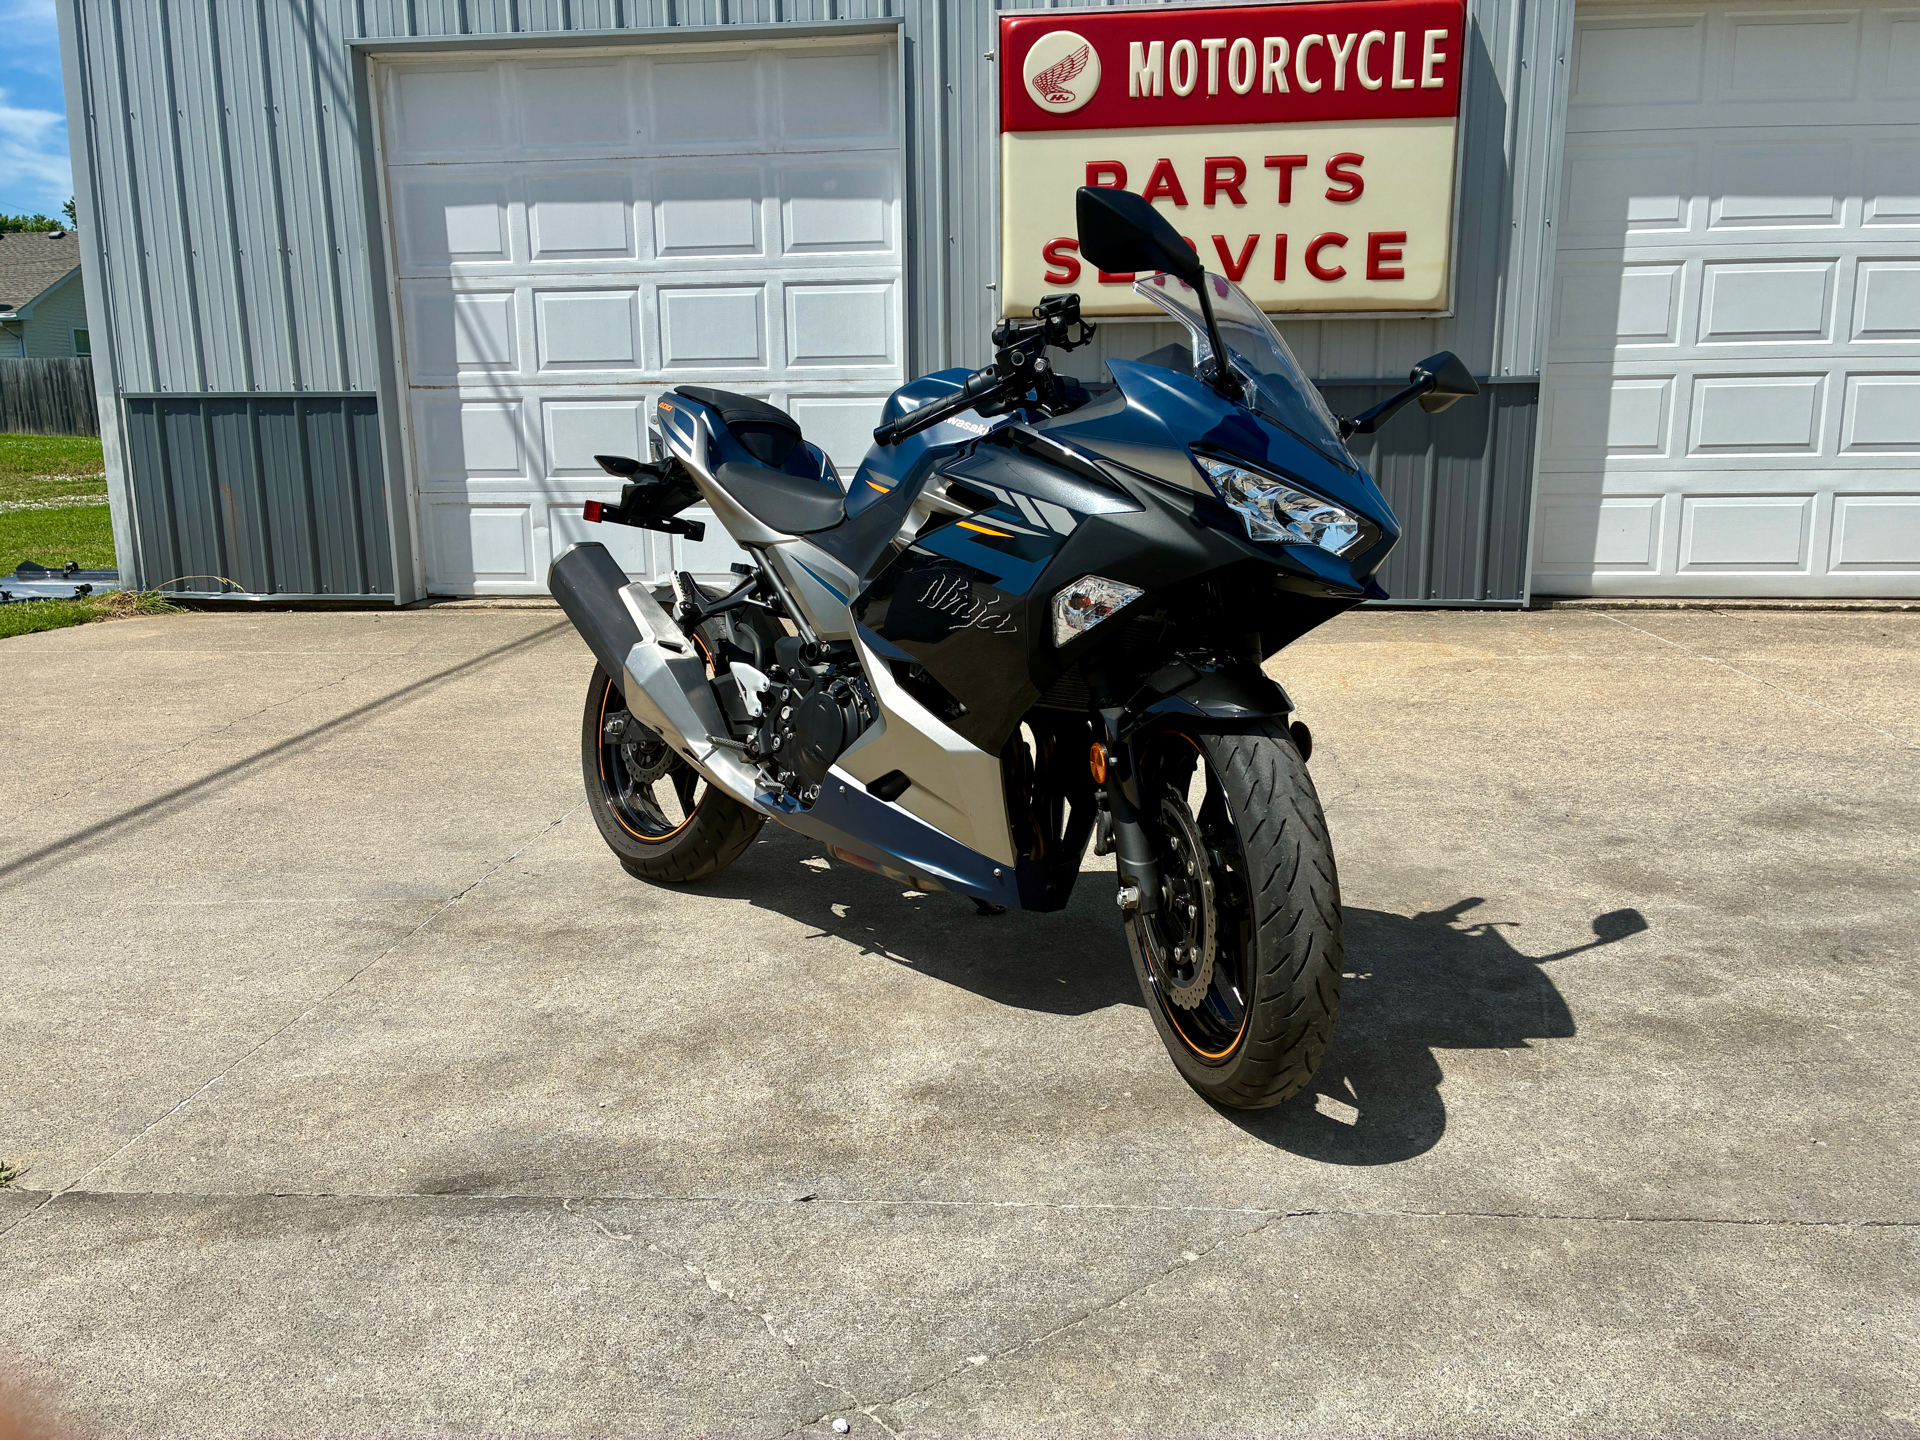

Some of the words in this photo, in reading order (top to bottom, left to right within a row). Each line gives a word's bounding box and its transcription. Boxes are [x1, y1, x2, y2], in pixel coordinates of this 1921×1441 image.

[1129, 28, 1449, 98] MOTORCYCLE
[1085, 152, 1365, 206] PARTS
[1043, 230, 1407, 284] SVICE
[944, 416, 990, 436] wasaki
[917, 573, 1018, 634] Ninja
